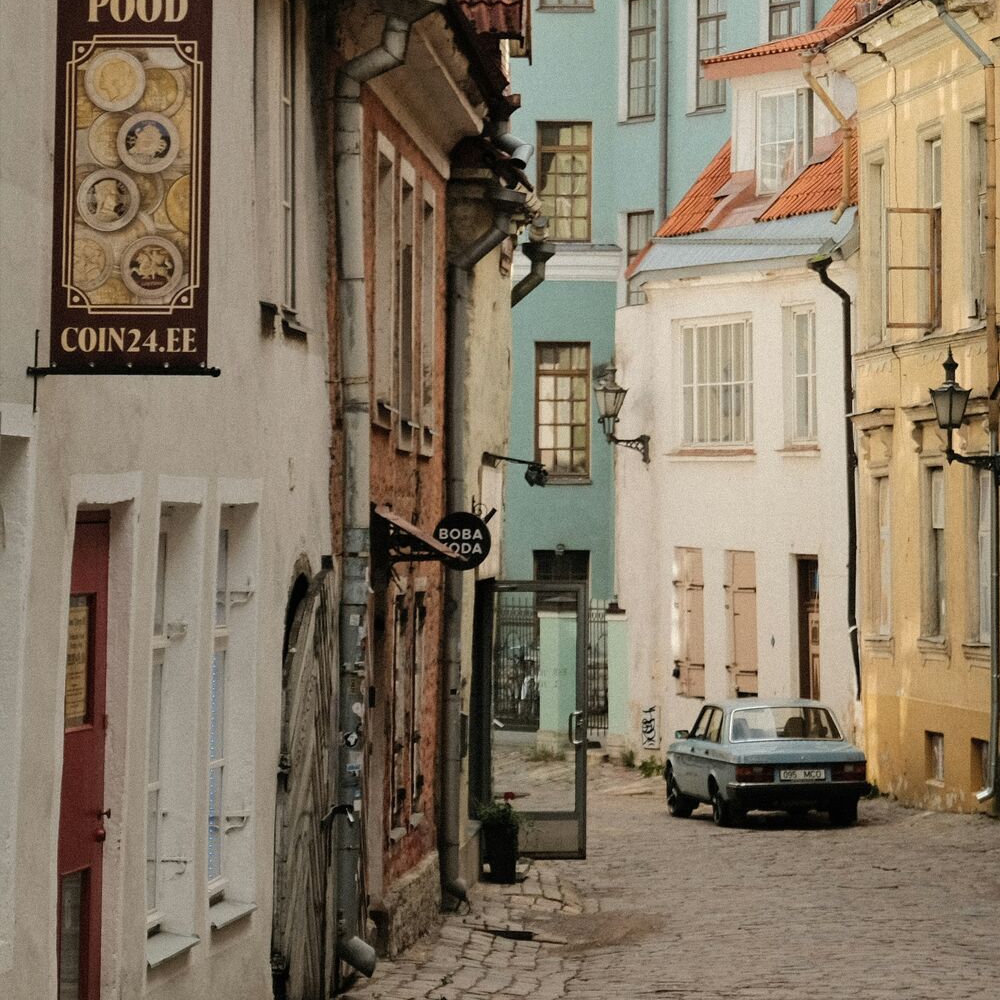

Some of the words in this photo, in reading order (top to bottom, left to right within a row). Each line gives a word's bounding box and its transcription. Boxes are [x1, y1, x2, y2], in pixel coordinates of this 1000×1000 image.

[60, 326, 197, 353] COIN24.EE
[438, 528, 483, 540] BOBA
[443, 542, 483, 554] ODA
